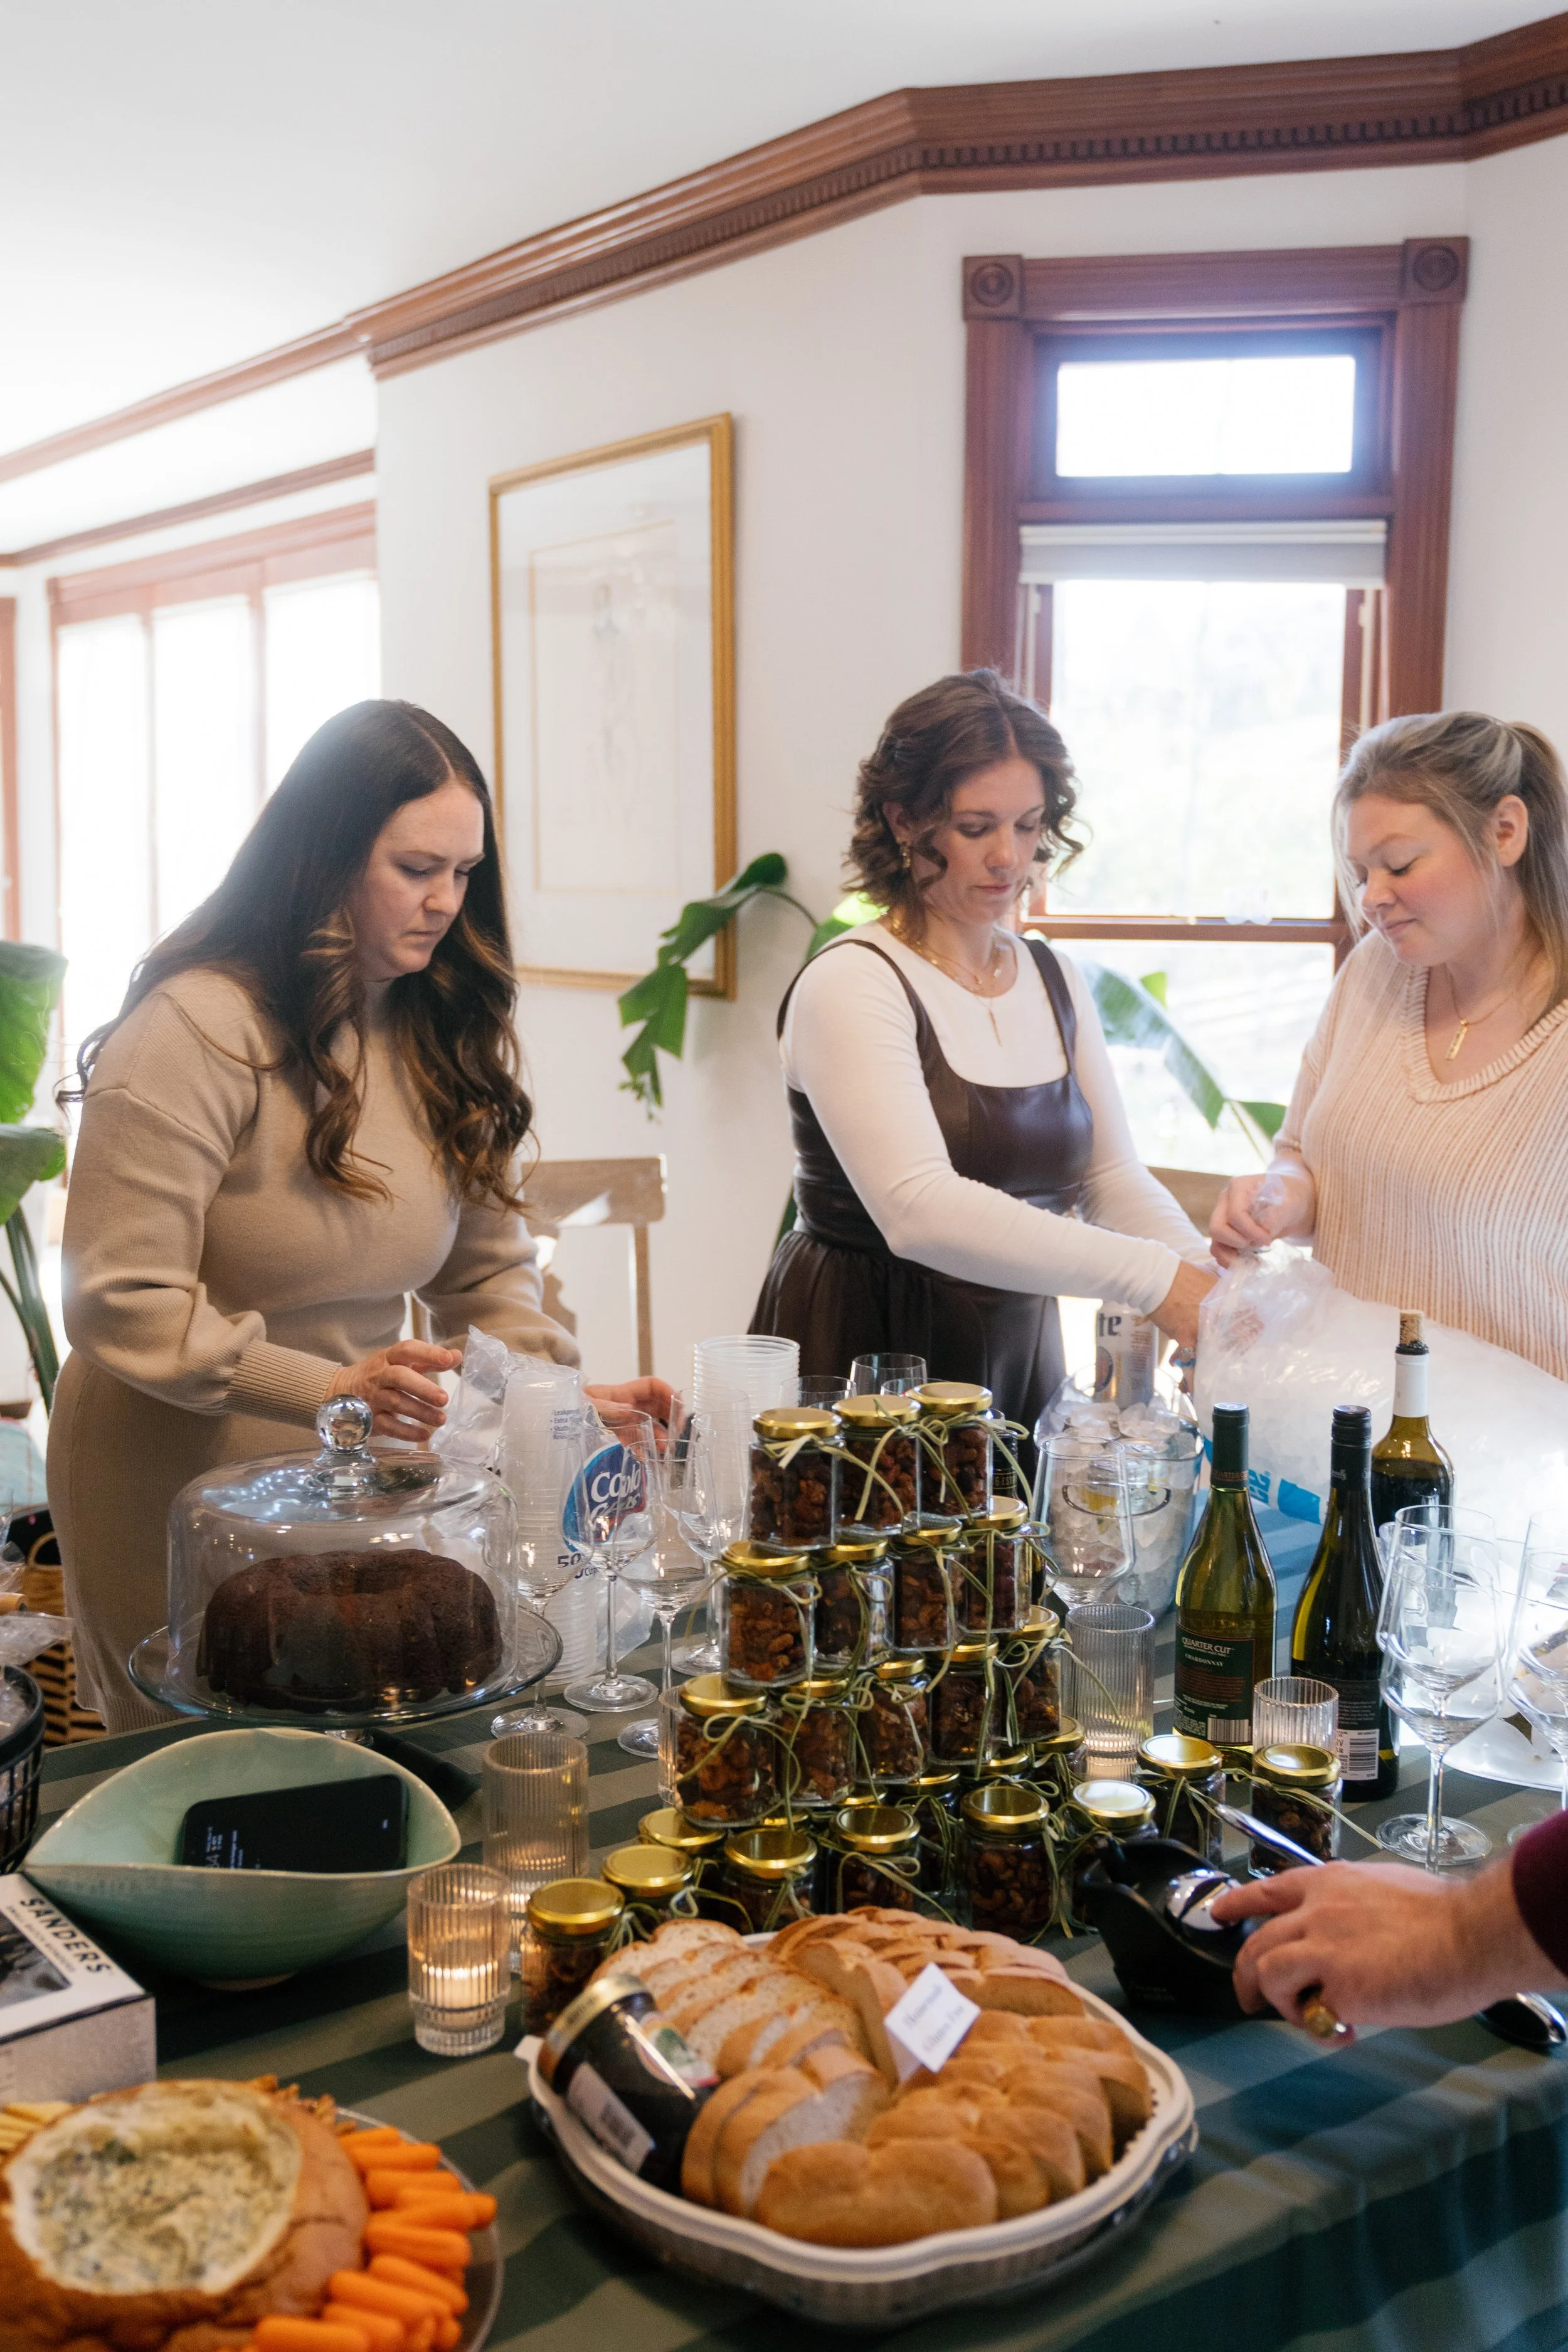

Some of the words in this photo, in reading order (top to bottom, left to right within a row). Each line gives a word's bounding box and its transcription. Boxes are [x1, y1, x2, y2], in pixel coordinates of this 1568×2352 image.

[557, 1552, 583, 1569] 50
[1182, 1636, 1214, 1651] QUARTER
[1214, 1645, 1231, 1655] CUT
[1185, 1653, 1224, 1666] CHARDONNAY
[20, 1899, 111, 1973] SANDERS
